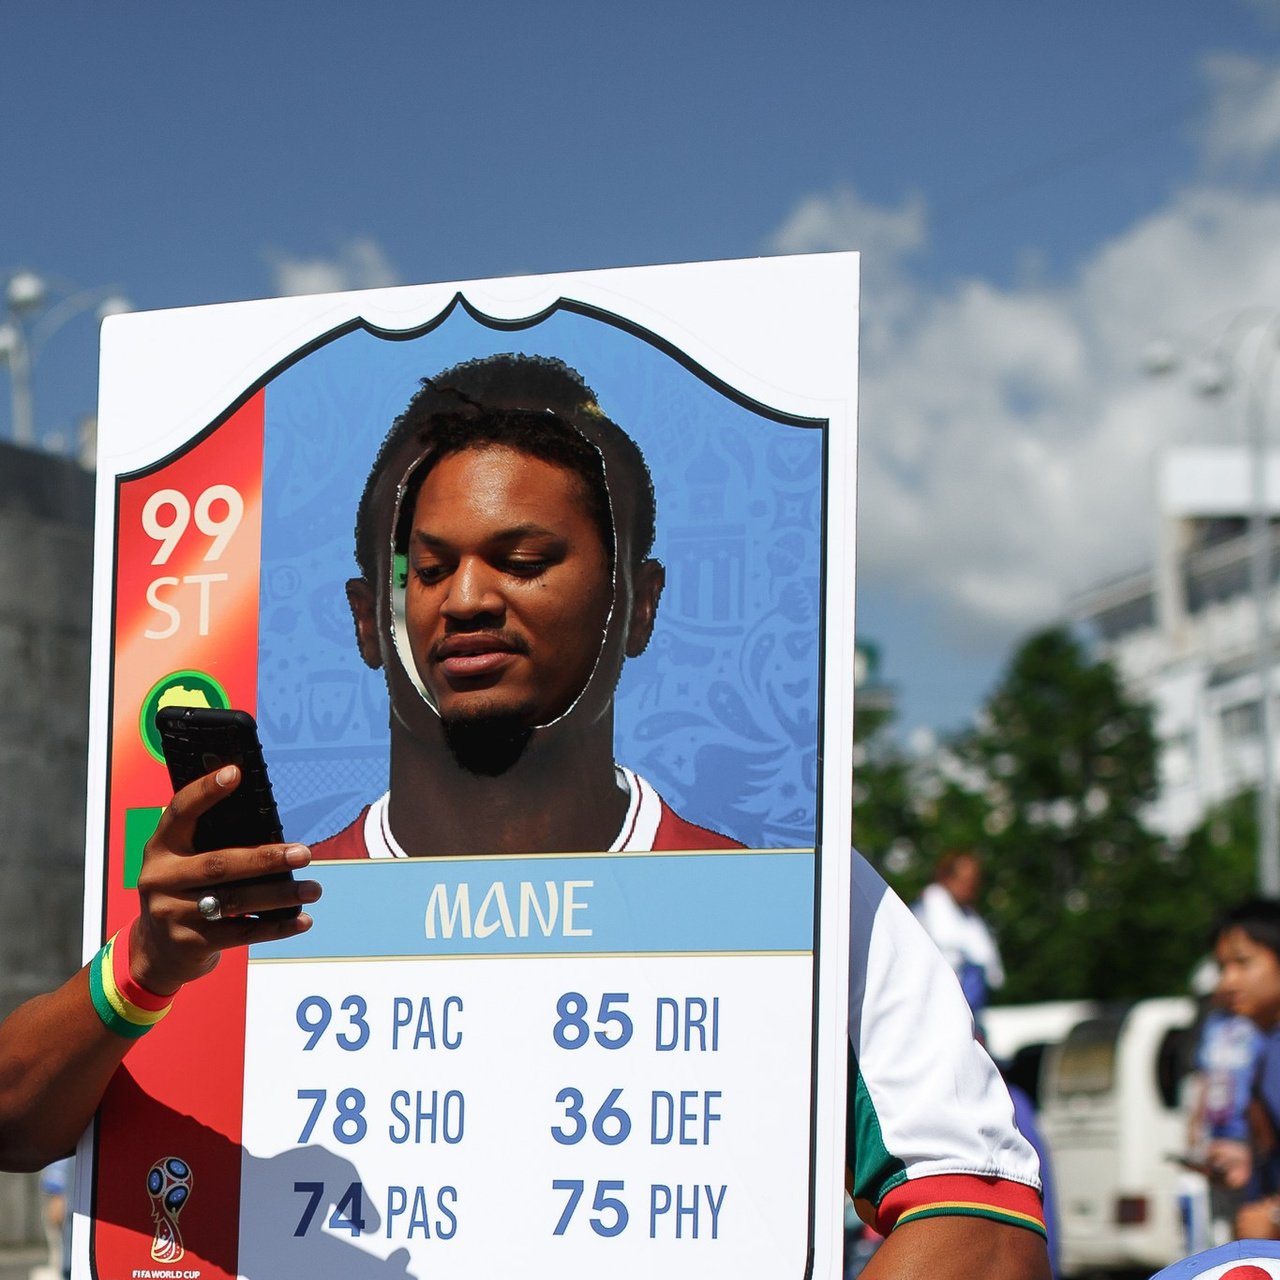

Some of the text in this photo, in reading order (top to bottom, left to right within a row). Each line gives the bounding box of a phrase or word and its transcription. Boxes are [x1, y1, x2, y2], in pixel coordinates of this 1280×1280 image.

[141, 484, 245, 566] 99
[143, 573, 228, 640] ST
[424, 880, 595, 940] MANE
[295, 995, 464, 1051] 93 PAC
[553, 992, 720, 1051] 85 DRI
[297, 1088, 465, 1144] 78 SHO
[550, 1087, 722, 1145] 36 DEF
[293, 1182, 457, 1240] 74 PAS
[552, 1180, 727, 1240] 75 PHY
[132, 1270, 201, 1279] FIFA WORLD CUP
